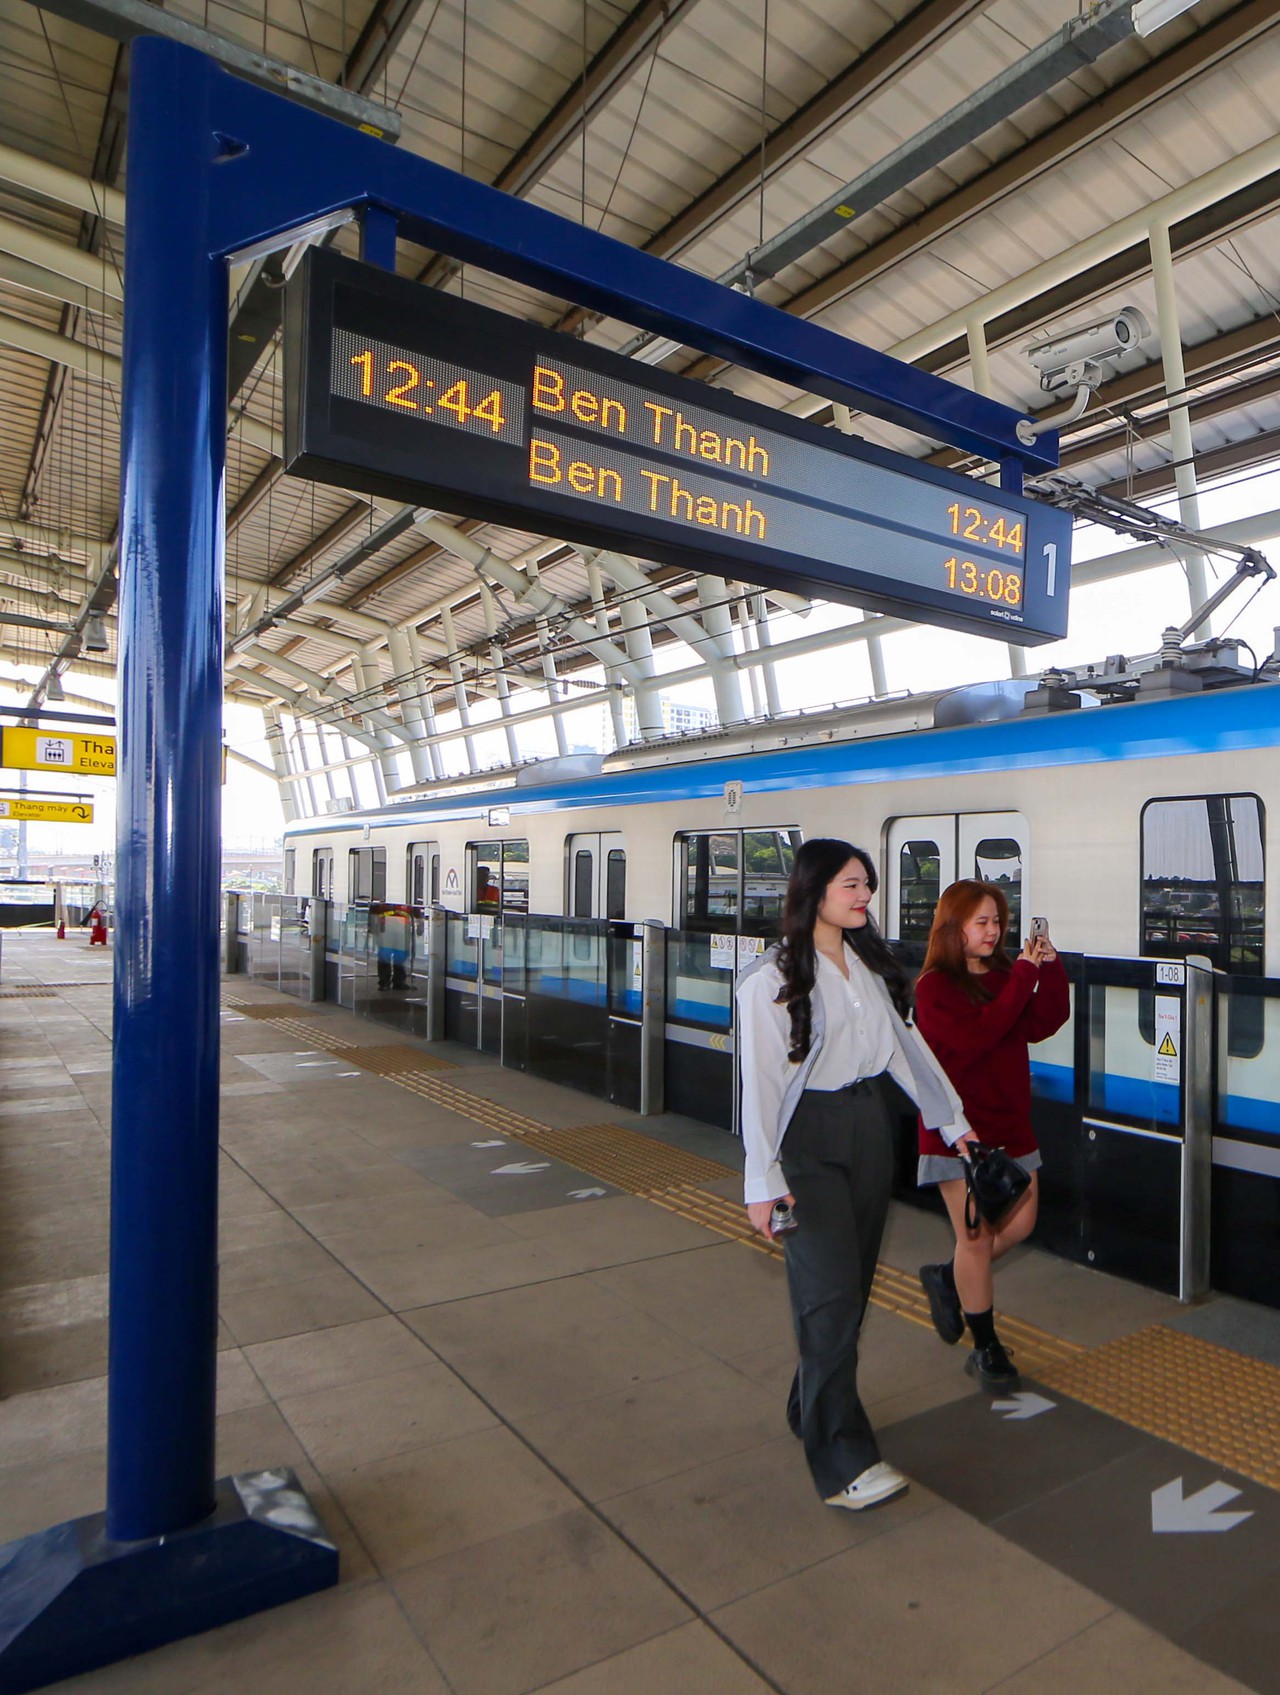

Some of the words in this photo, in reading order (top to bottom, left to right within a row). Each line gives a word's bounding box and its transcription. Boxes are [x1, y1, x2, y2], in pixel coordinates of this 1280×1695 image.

[350, 350, 507, 432] 12:44
[533, 365, 626, 433] Ben
[644, 402, 769, 477] Thanh
[529, 438, 623, 502] Ben
[640, 469, 766, 539] Thanh
[947, 503, 1023, 553] 12:44
[944, 557, 1021, 605] 13:08
[1043, 543, 1057, 597] 1
[14, 802, 44, 812] Thang
[1160, 967, 1179, 982] 1-08
